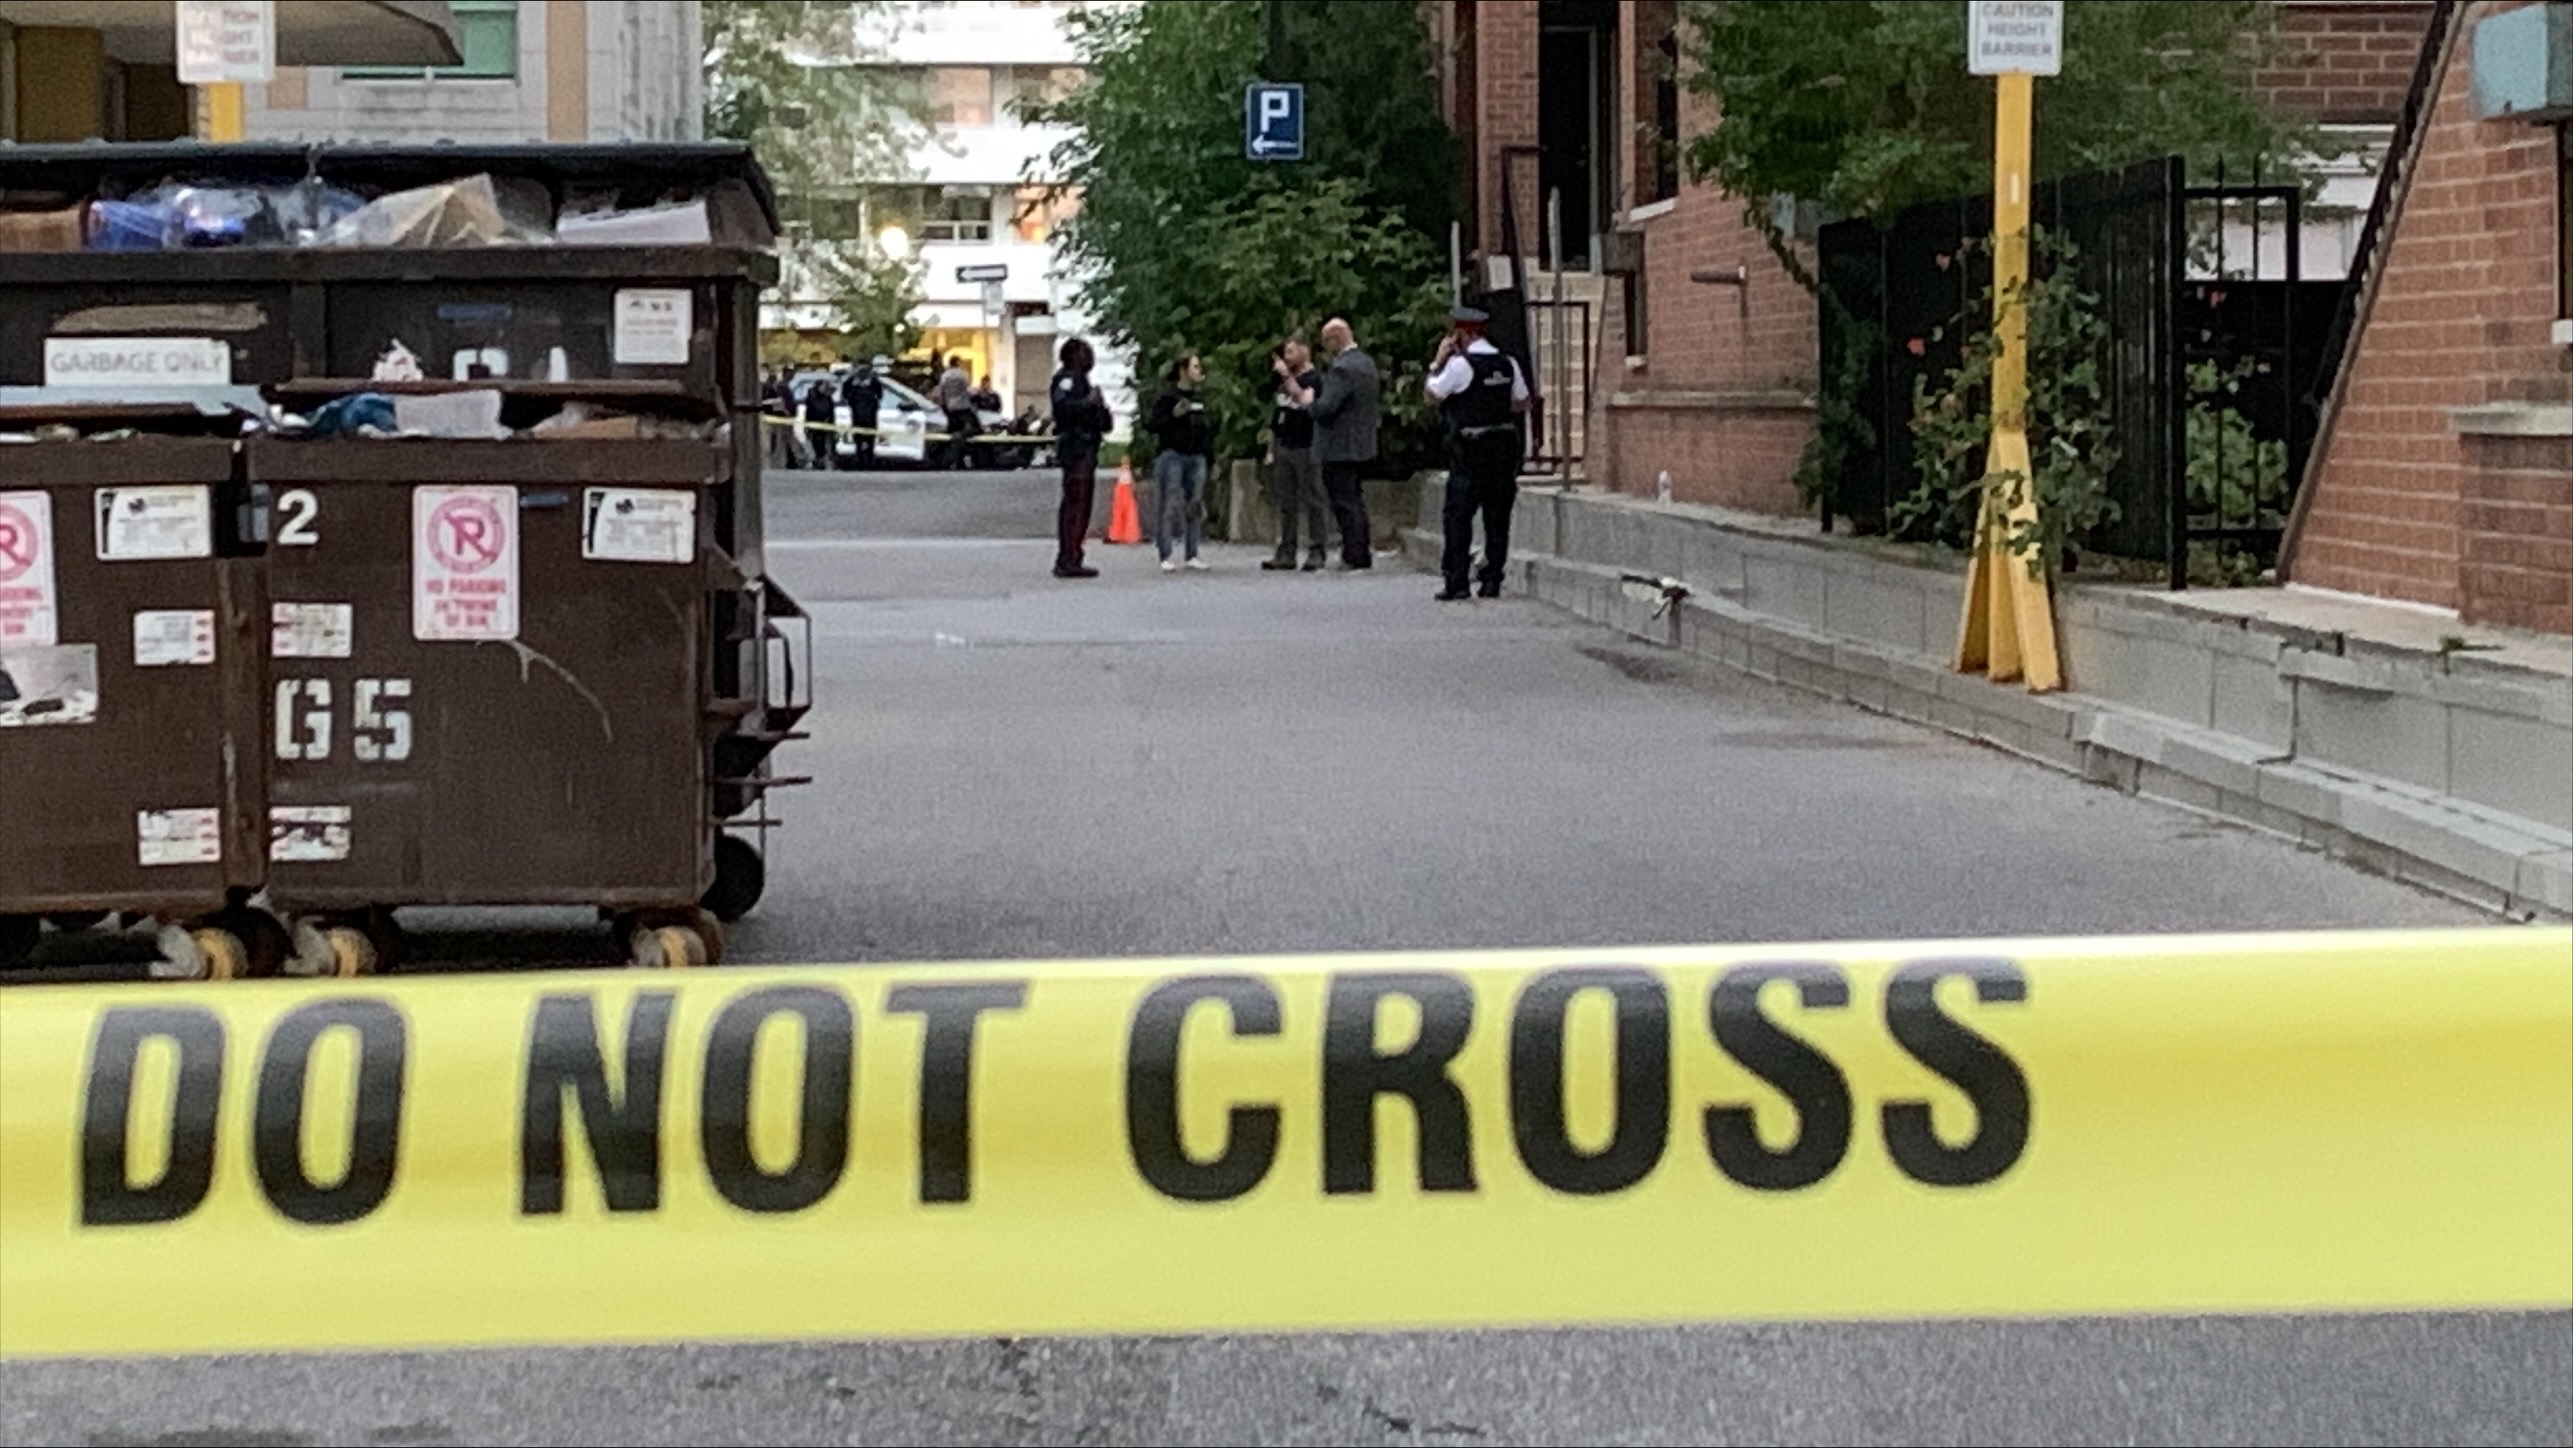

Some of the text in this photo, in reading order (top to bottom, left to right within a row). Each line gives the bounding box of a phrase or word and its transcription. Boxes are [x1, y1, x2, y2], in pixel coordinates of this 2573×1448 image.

[1982, 2, 2054, 17] CAUTION
[1987, 22, 2046, 36] HEIGHT
[1981, 42, 2052, 57] BARRIER
[1260, 90, 1289, 133] P
[51, 351, 222, 373] GARBAGE ONLY
[277, 489, 320, 545] 2
[79, 957, 2034, 1227] DO NOT CROSS
